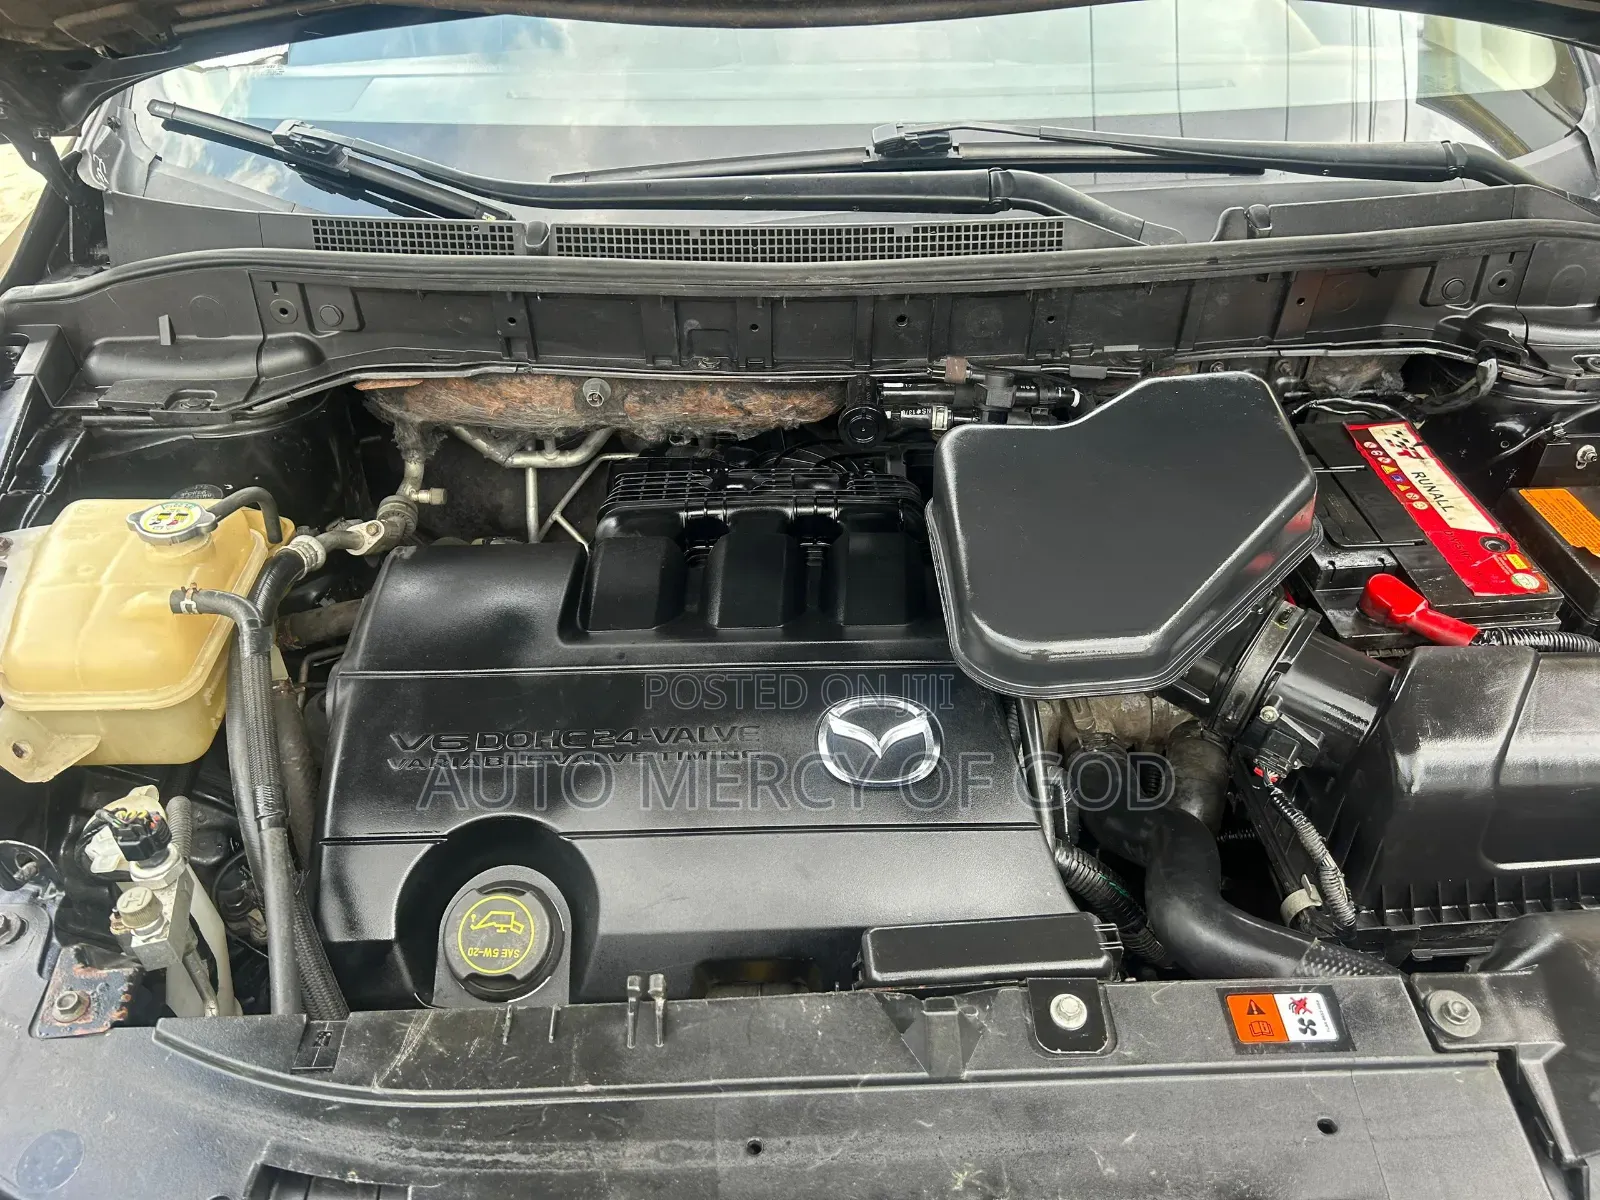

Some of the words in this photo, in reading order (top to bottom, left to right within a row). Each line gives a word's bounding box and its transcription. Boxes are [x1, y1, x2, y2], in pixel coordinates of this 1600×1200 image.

[1411, 471, 1455, 513] RUNALL
[389, 732, 469, 752] V6
[475, 729, 588, 750] DOHC
[592, 725, 761, 747] 24-VALVE
[387, 754, 544, 770] VARIABLE
[552, 751, 646, 767] VALVE
[467, 947, 500, 958] 5W-20
[500, 948, 521, 959] SAE
